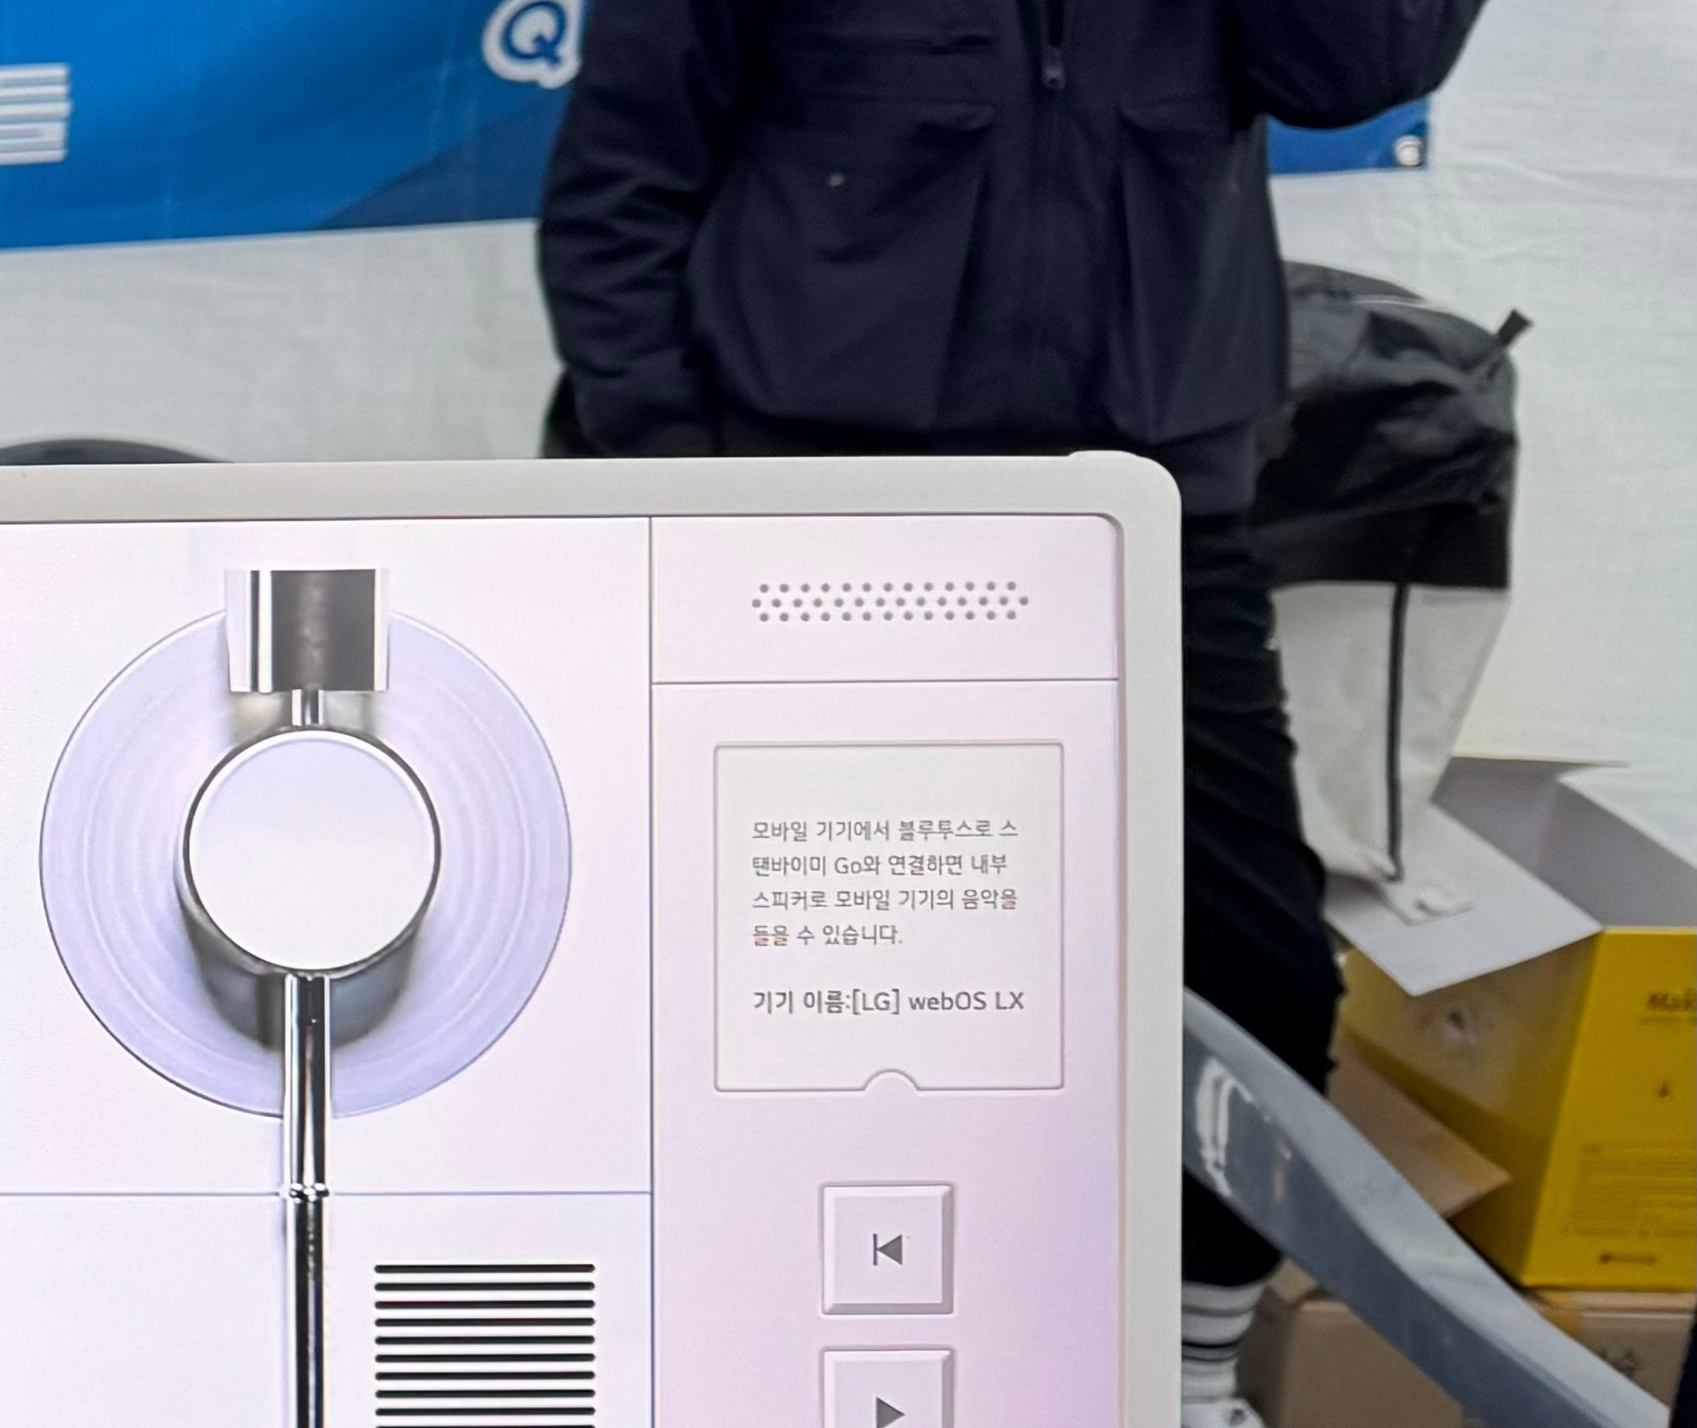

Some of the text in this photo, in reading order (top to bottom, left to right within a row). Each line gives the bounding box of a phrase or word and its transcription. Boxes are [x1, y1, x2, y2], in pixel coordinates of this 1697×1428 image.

[752, 820, 1018, 842] 모바일 기기에서 블루투스로 스
[752, 854, 1007, 877] 탠바이미 Go와 연결하면 내부
[752, 889, 1017, 911] 스피커로 모바일 기기의 음악을
[752, 924, 903, 947] 들을 수 있습니다.
[754, 988, 1025, 1015] 기기 이름:[LG] webOS LX
